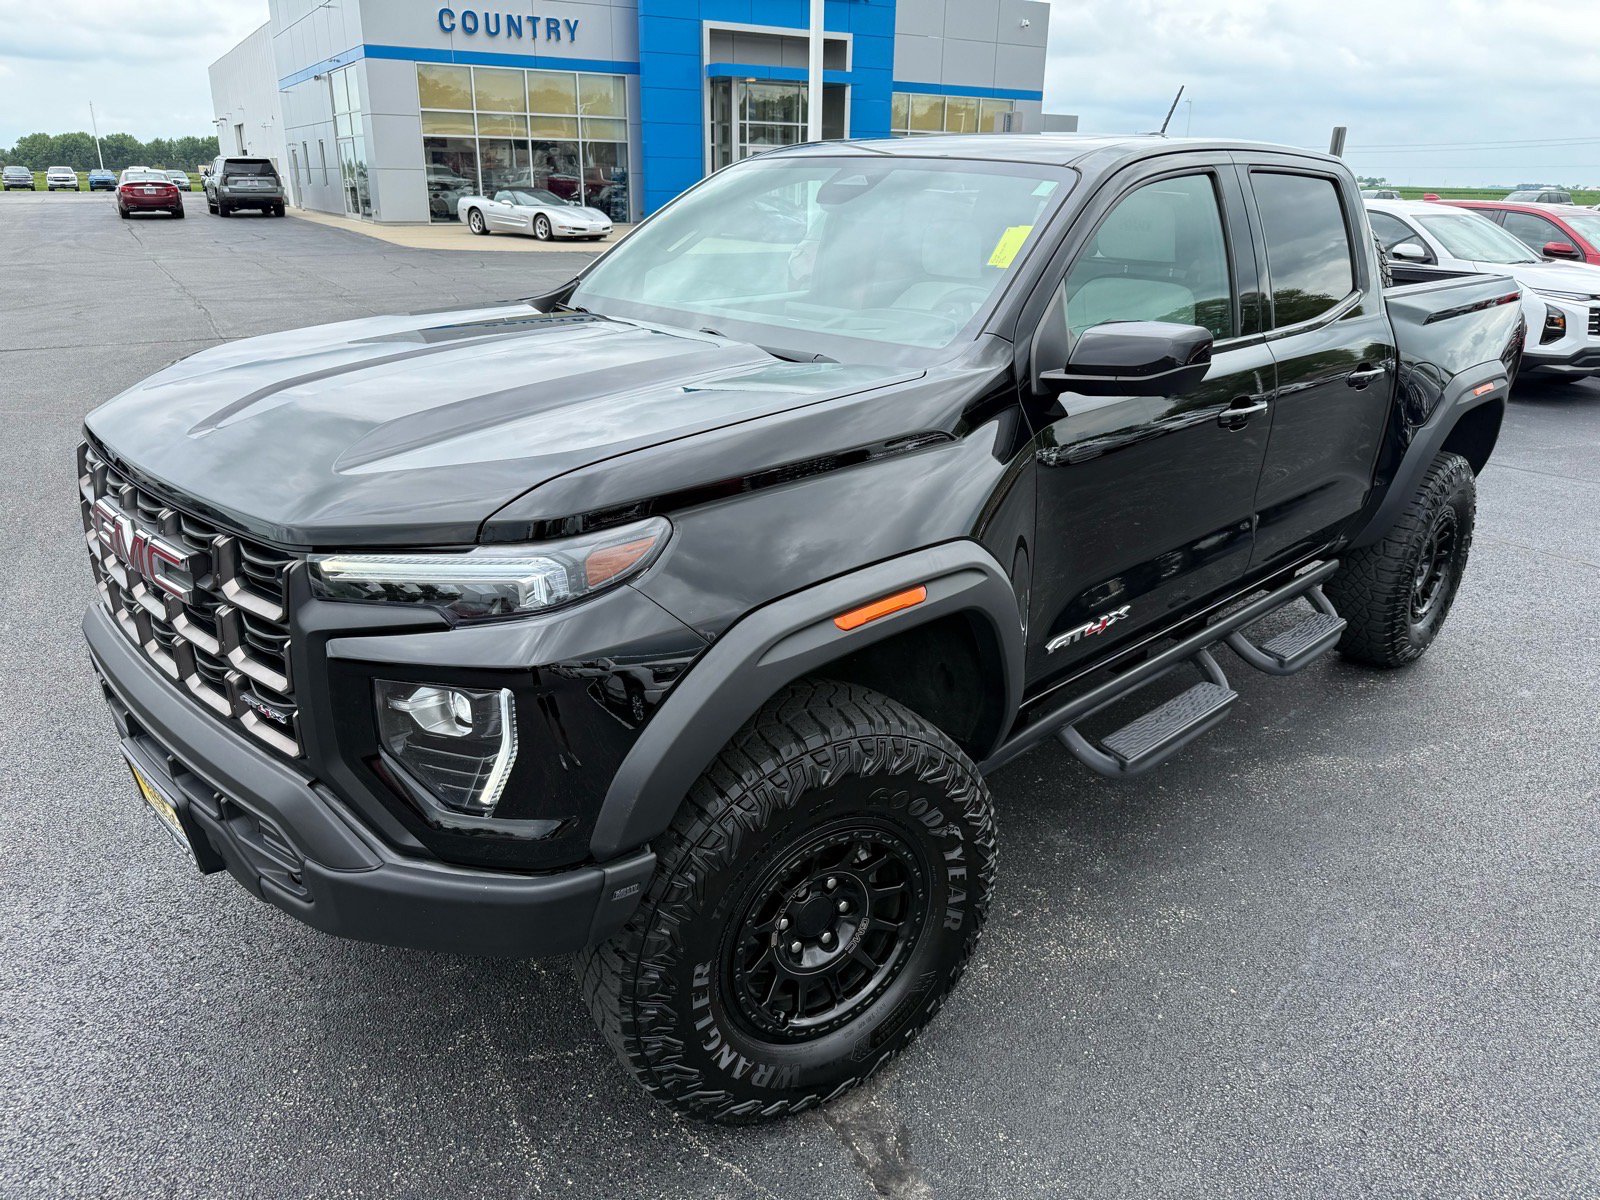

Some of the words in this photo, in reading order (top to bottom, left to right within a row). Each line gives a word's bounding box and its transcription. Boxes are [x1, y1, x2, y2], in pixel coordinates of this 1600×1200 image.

[438, 8, 579, 42] COUNTRY
[92, 498, 193, 603] GMC
[1045, 605, 1131, 654] AT4X
[844, 917, 870, 954] GMC
[691, 960, 800, 1088] WRANGLER
